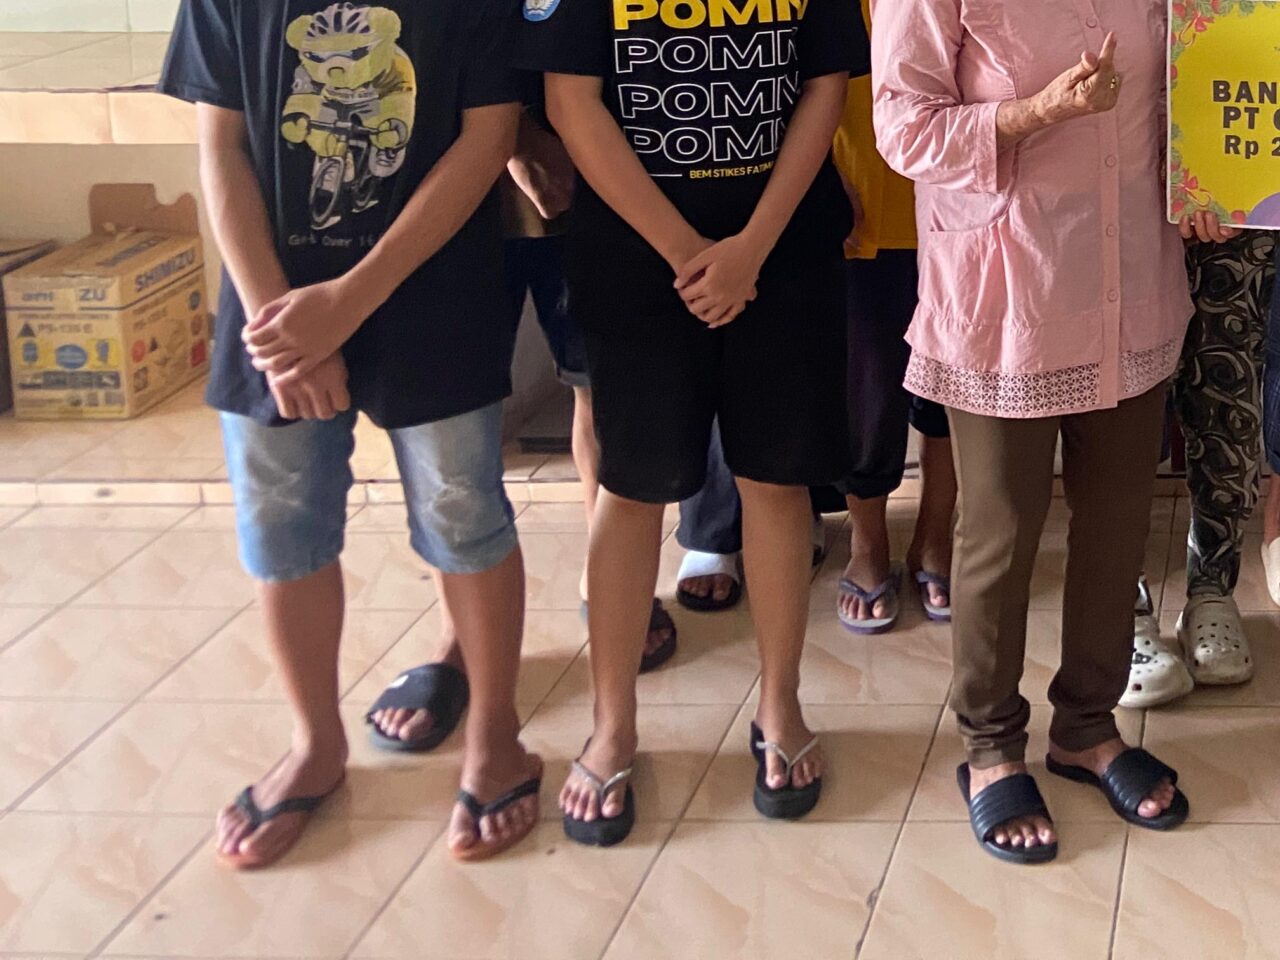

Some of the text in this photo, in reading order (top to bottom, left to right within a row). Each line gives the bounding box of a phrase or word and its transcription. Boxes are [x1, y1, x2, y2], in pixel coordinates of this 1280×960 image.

[1223, 106, 1260, 130] PT
[622, 116, 787, 164] POM
[1225, 135, 1259, 159] Rp
[689, 169, 712, 179] BEM
[713, 167, 746, 178] STIKES
